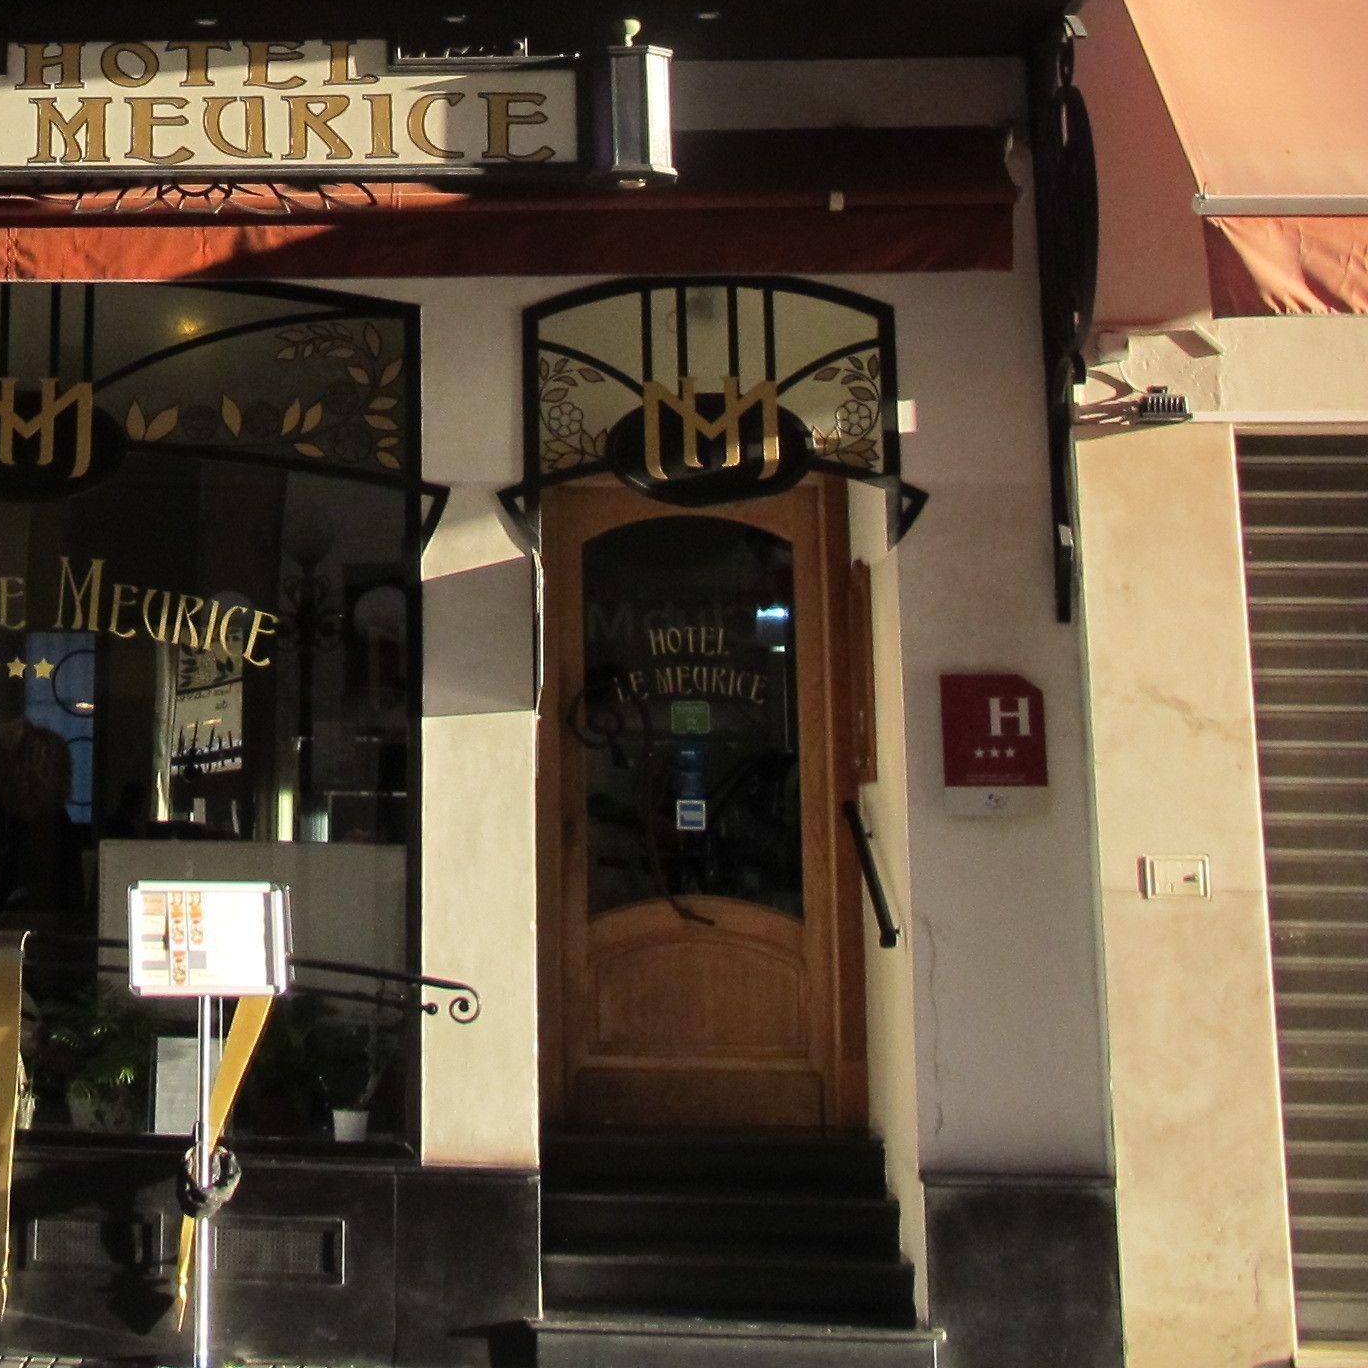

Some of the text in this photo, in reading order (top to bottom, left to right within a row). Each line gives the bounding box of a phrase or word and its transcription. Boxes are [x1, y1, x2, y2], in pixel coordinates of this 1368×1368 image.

[15, 40, 377, 90] HOTEL
[28, 92, 557, 164] MEURICE
[649, 625, 729, 656] HOTEL
[613, 666, 767, 704] LE MEURICE
[989, 697, 1030, 736] H
